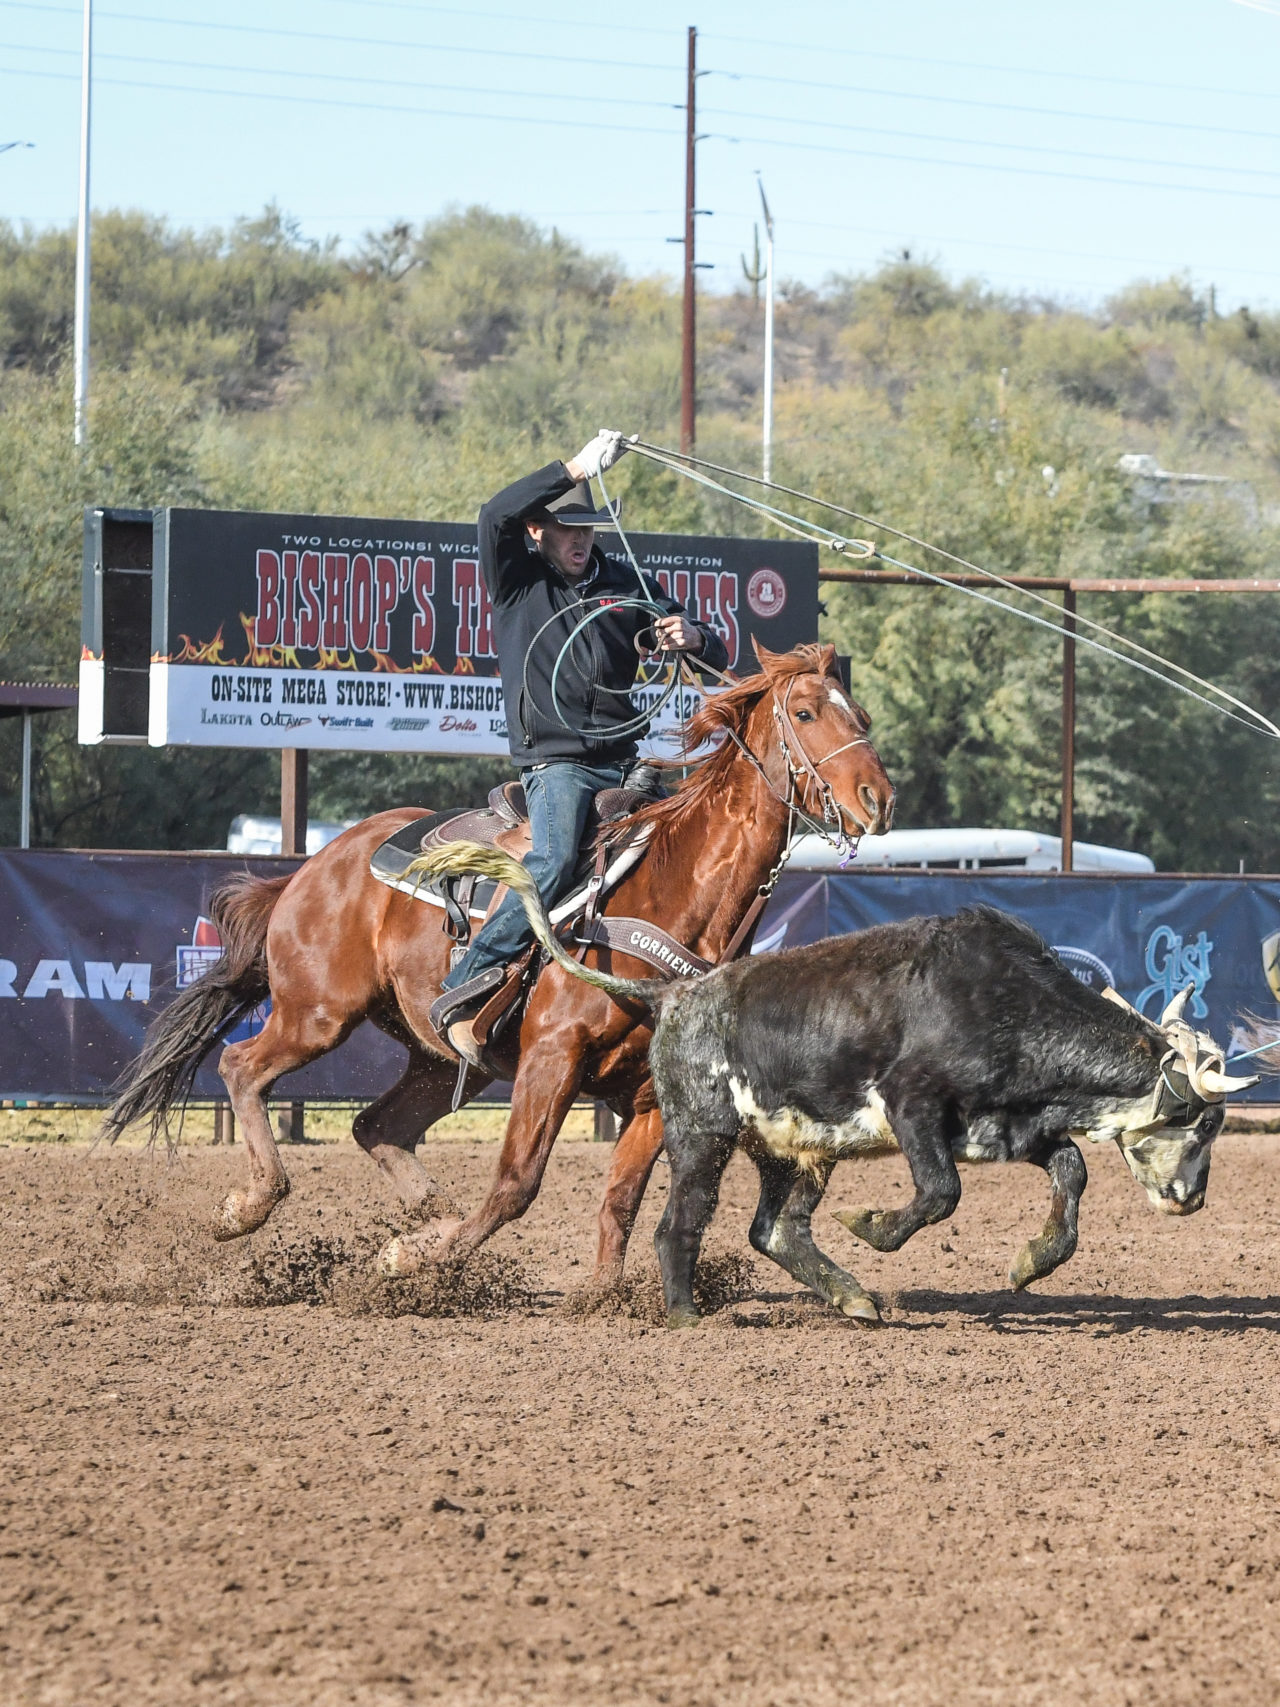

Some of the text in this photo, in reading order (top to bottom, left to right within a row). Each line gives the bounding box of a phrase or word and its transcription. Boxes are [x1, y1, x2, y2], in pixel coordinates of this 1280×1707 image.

[282, 534, 480, 554] TWO LOCATIONS! WICK
[643, 554, 723, 567] JUNCTION
[255, 549, 436, 656] BISHOP'S
[211, 674, 504, 712] ON-SITE MEGA STORE! WWW.BISHOP
[201, 708, 253, 726] LAKOTA
[630, 931, 703, 977] CORRIENT
[1143, 925, 1214, 996] Gist
